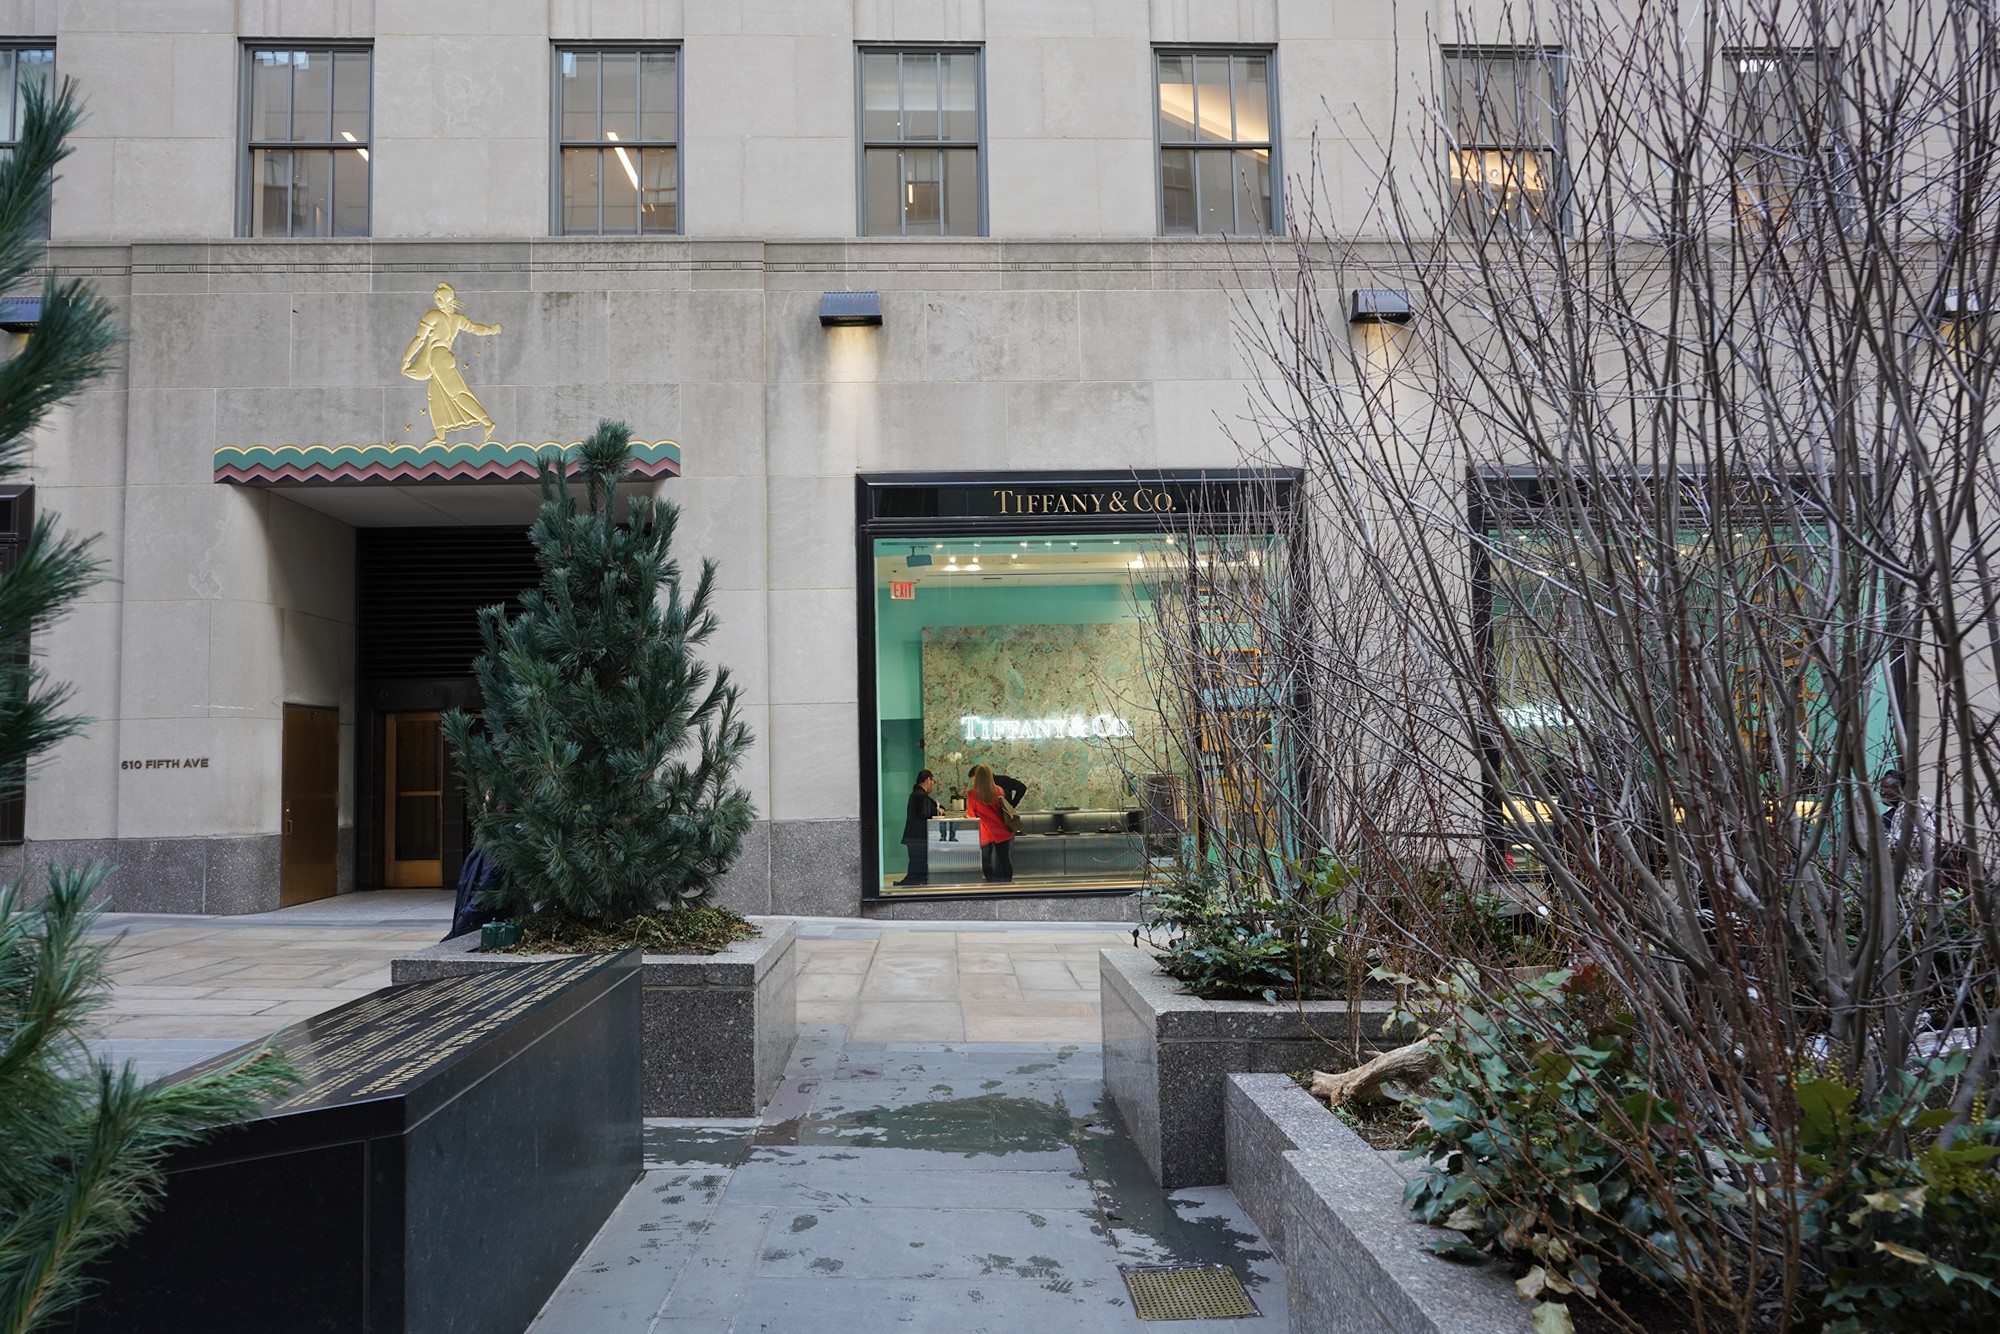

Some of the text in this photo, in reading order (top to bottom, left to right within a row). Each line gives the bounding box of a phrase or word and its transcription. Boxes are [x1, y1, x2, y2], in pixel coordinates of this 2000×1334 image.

[993, 490, 1105, 514] TIFFANY
[1108, 490, 1128, 512] &
[892, 582, 913, 598] EXIT
[960, 715, 1067, 740] TIFFANY
[1069, 716, 1088, 738] &
[121, 759, 209, 770] 610 FIFTH AVE
